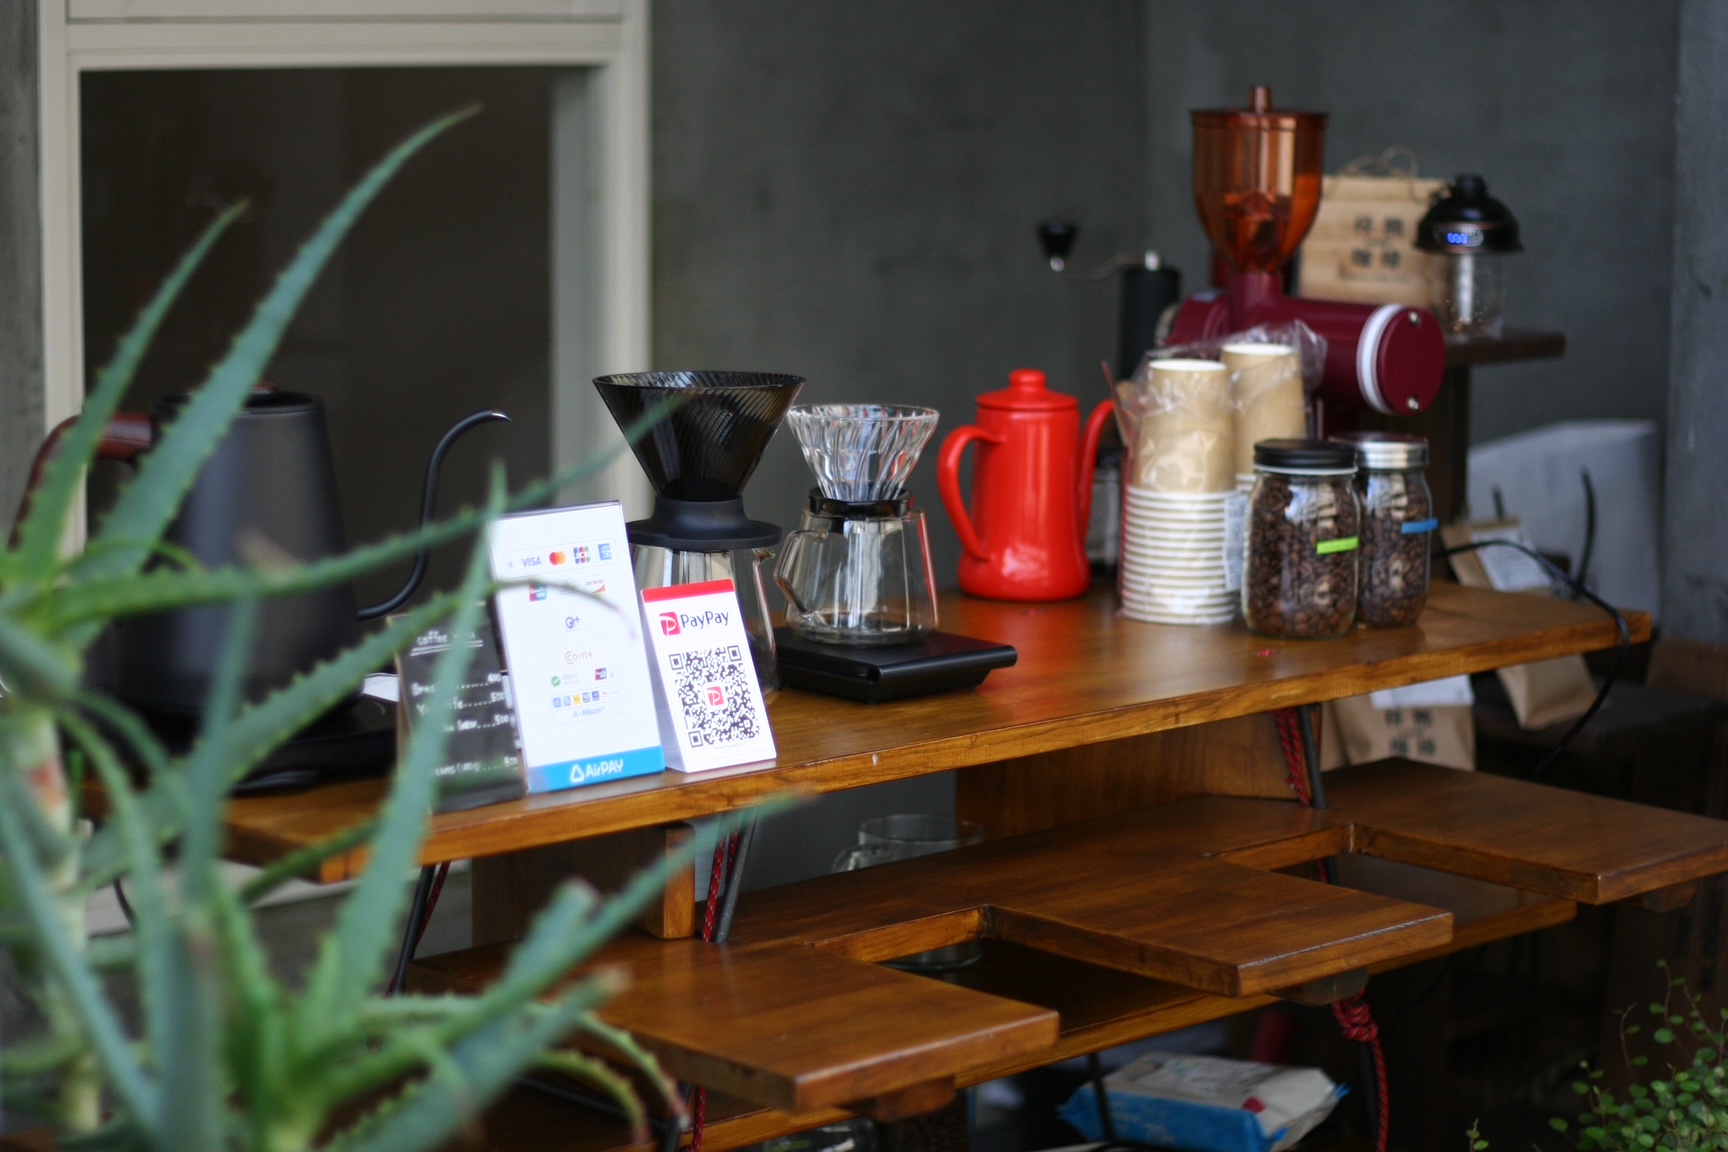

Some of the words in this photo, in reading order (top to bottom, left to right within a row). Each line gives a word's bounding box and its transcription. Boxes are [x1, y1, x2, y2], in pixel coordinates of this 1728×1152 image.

[521, 557, 542, 567] VISA
[680, 610, 729, 630] PayPay
[585, 758, 624, 778] AirPAY
